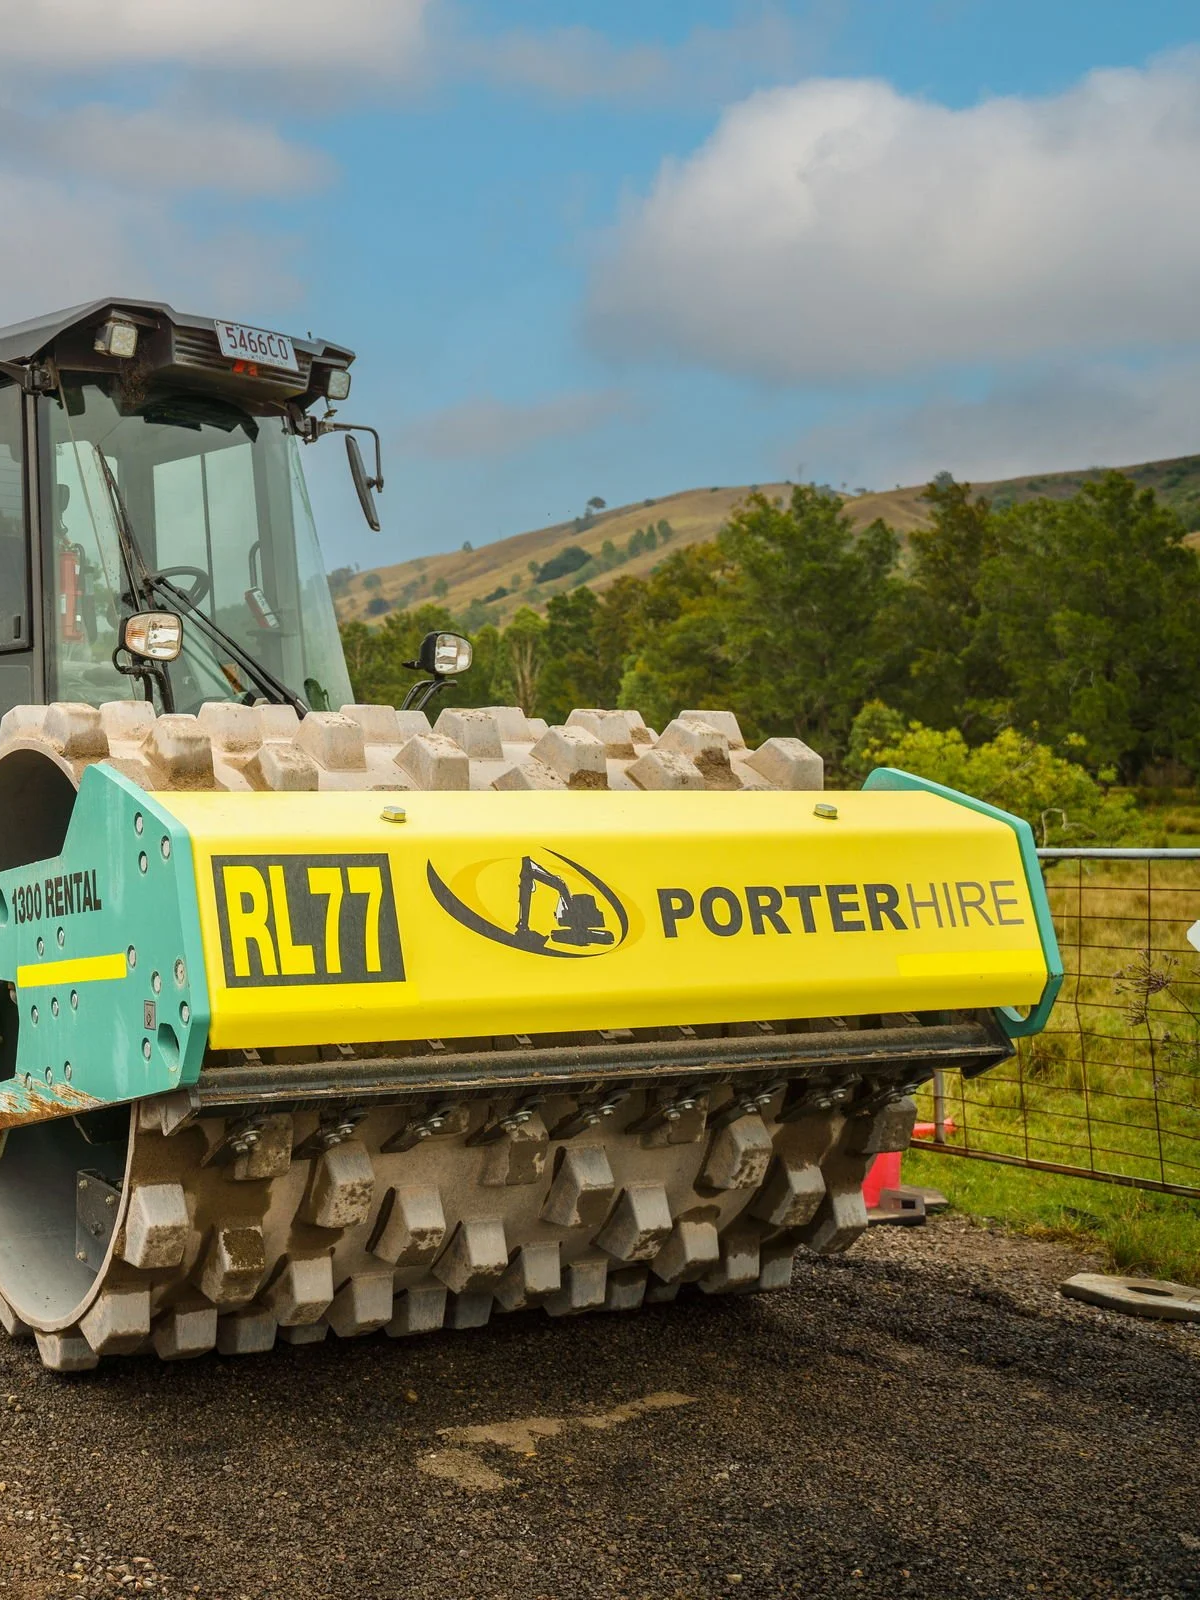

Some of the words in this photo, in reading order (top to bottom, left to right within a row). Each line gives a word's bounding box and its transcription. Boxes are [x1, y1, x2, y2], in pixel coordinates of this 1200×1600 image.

[12, 883, 42, 924] 1300
[45, 869, 102, 919] RENTAL
[222, 865, 383, 976] RL77
